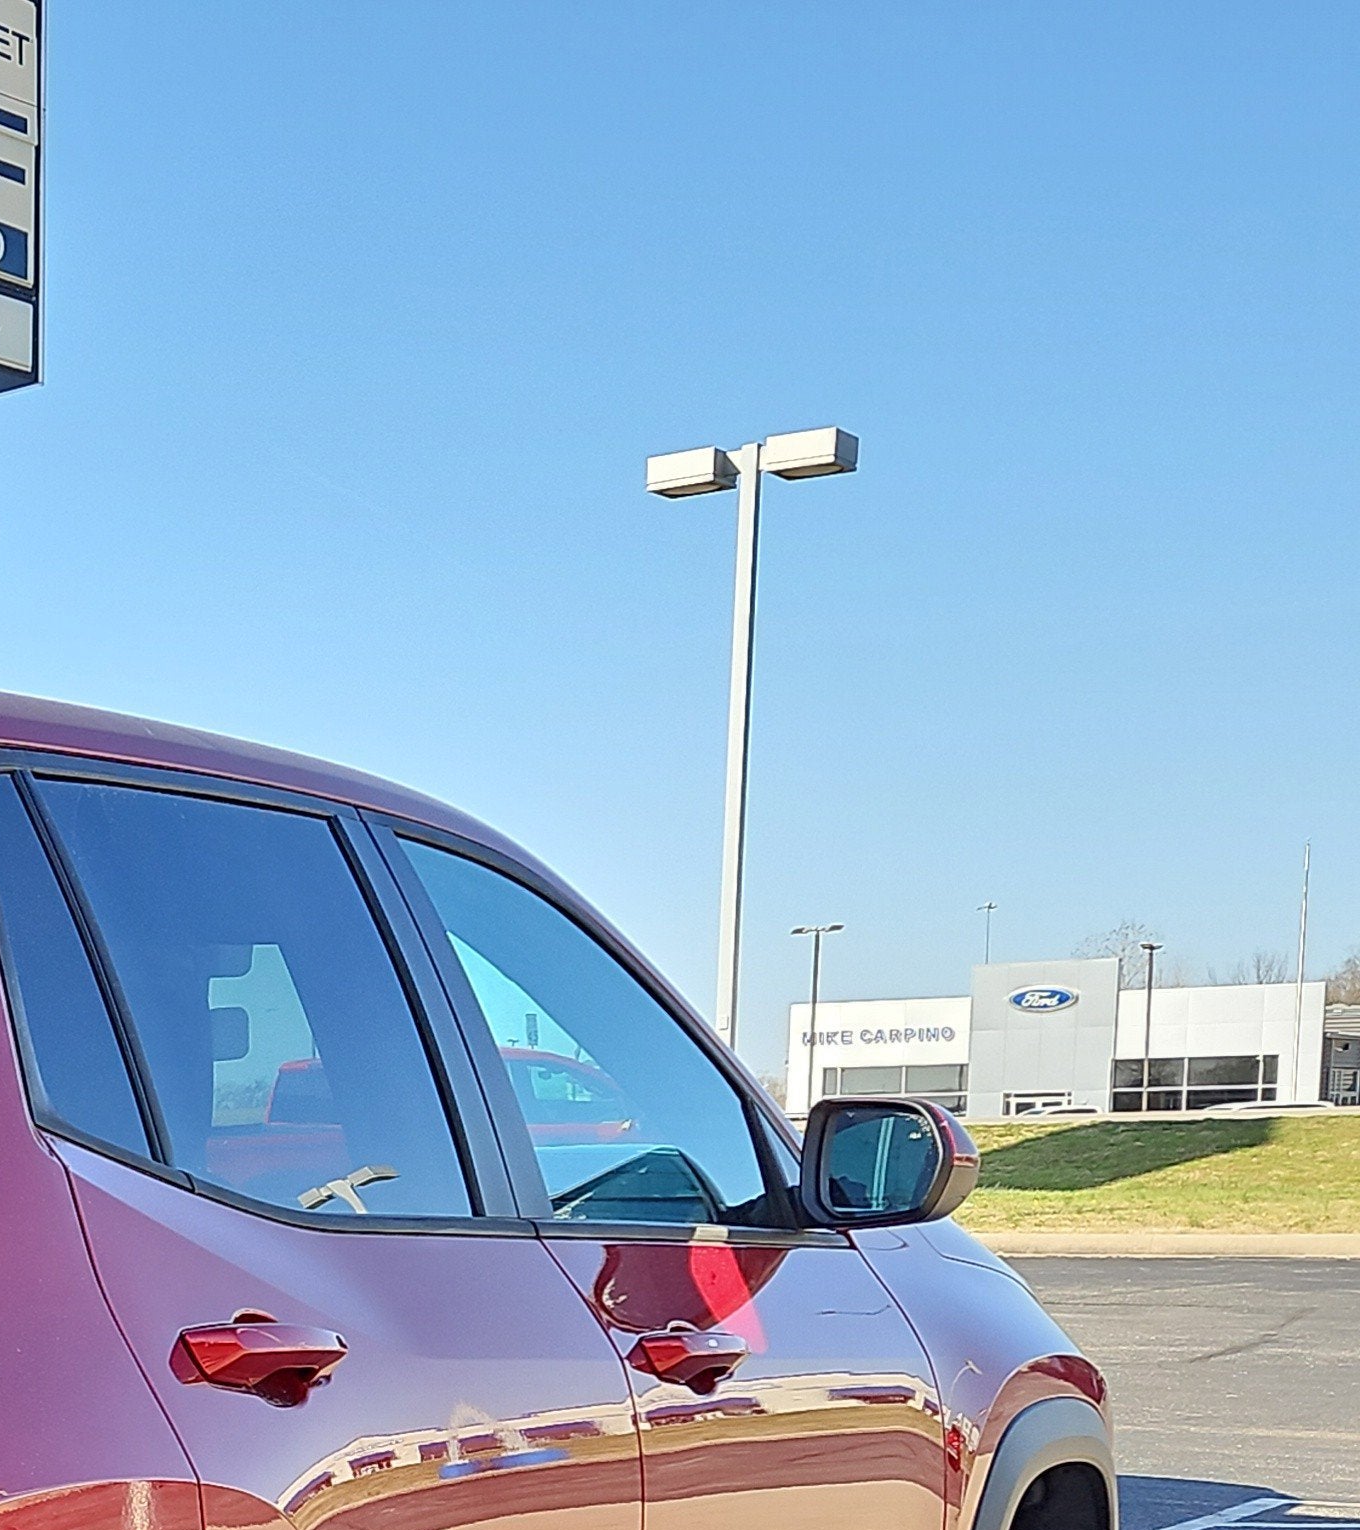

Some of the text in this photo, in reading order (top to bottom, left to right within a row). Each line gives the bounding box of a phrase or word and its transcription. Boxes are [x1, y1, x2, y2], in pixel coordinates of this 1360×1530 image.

[1021, 991, 1061, 1008] Ford
[802, 1026, 956, 1047] MIKE CARPINO
